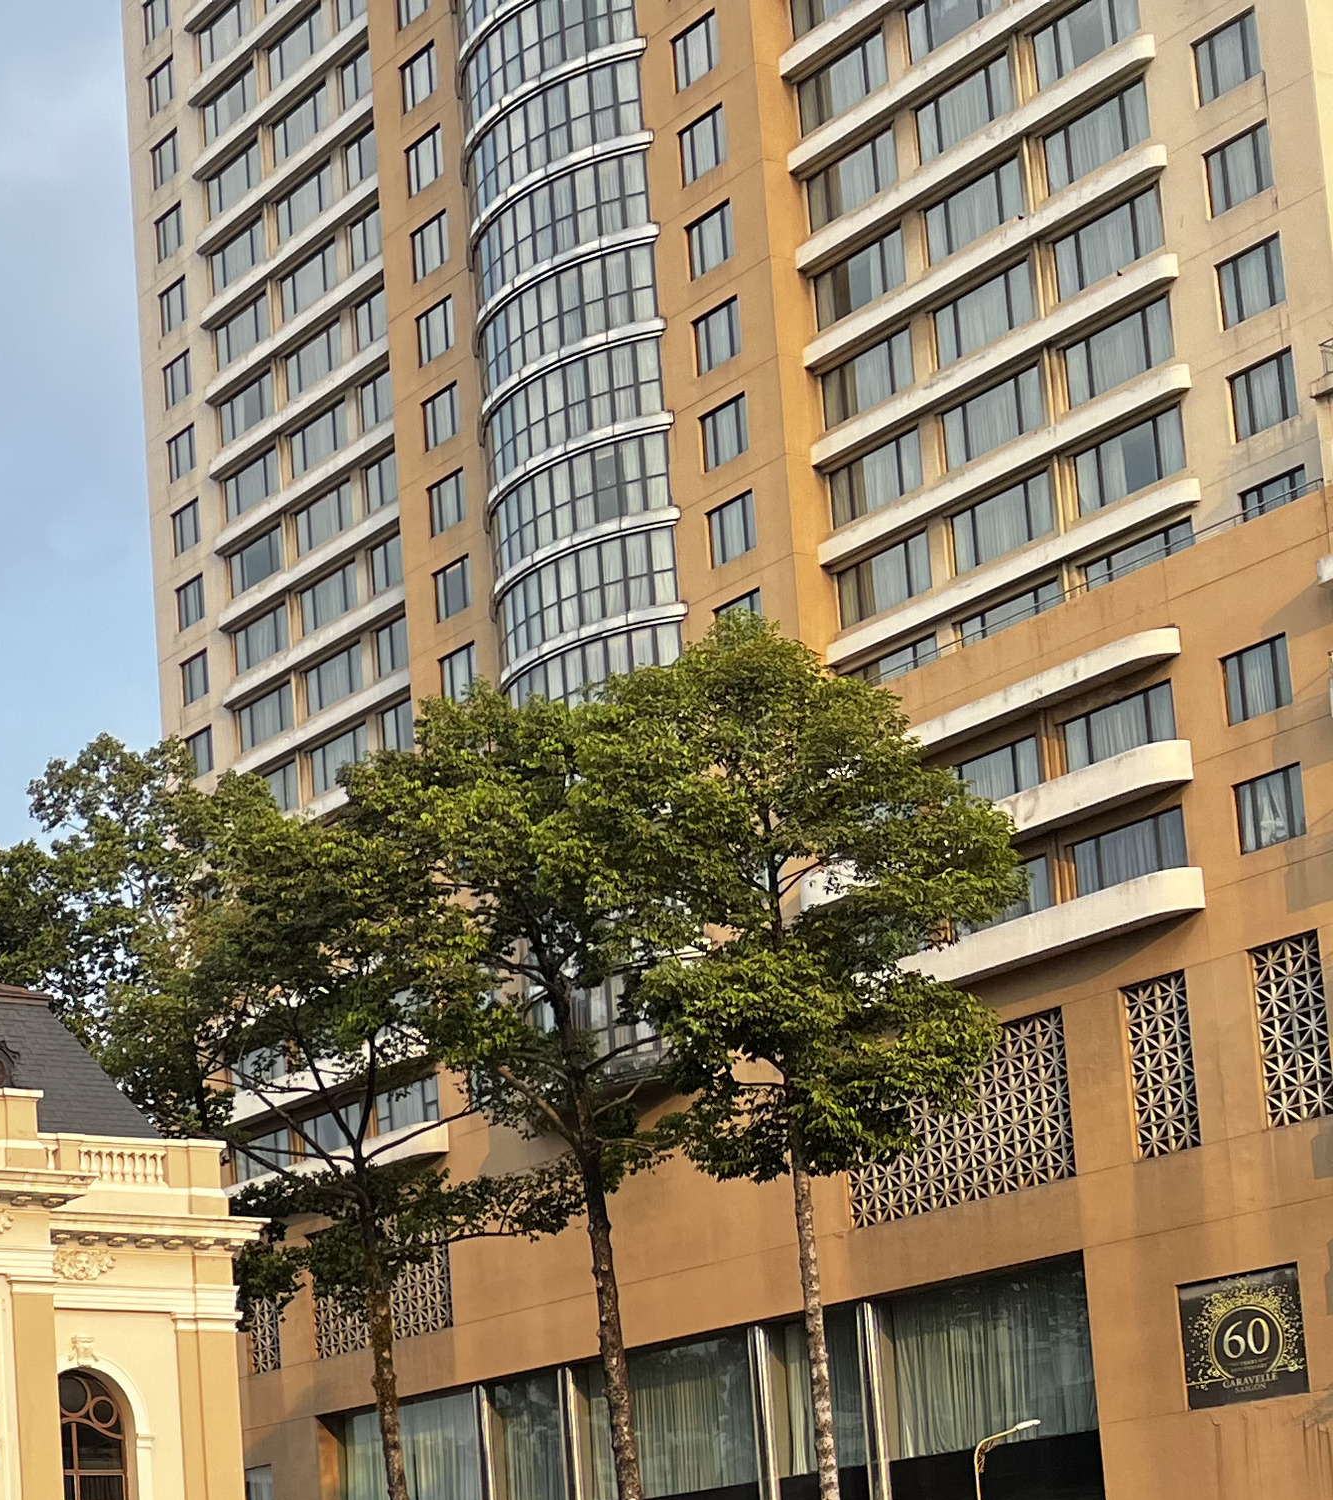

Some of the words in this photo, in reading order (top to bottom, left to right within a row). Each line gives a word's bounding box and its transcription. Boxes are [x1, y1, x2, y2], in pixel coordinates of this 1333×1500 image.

[1222, 1317, 1271, 1359] 60
[1222, 1372, 1279, 1389] CARAVELLE
[1234, 1383, 1267, 1394] SAIGON
